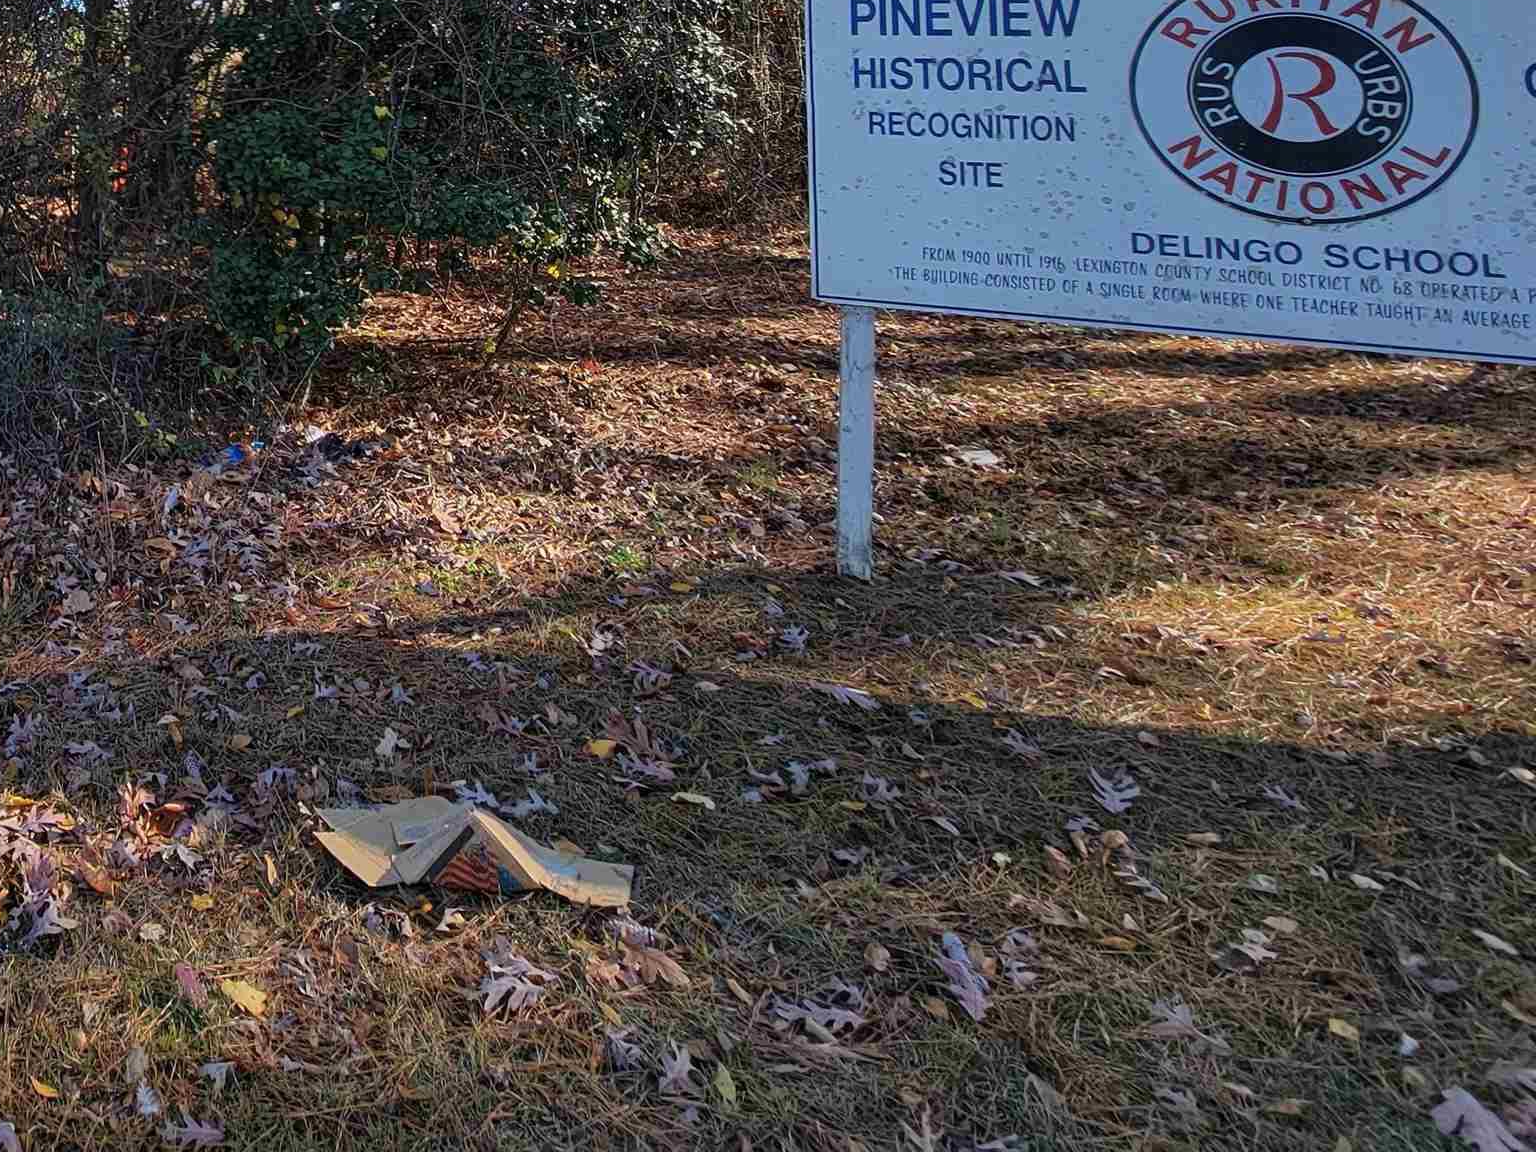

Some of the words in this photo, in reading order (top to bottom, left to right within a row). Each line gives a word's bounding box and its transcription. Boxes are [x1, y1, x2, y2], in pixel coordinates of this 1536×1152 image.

[853, 56, 1088, 93] HISTORICAL
[1197, 56, 1239, 128] RUS
[1354, 50, 1402, 144] URBS
[1262, 51, 1340, 136] R
[868, 111, 1076, 142] RECOGNITION
[938, 159, 1005, 188] SITE
[1167, 134, 1452, 215] NATIONAL
[922, 247, 956, 262] FROM
[961, 250, 991, 266] 1900
[997, 252, 1033, 269] UNTIL
[1075, 257, 1148, 277] LEXINGTON
[1155, 262, 1211, 281] COUNTY
[1219, 267, 1275, 287] SCHOOL
[1282, 271, 1353, 292] DISTRICT
[1393, 279, 1413, 295] 68
[1420, 281, 1501, 302] OPERATED
[1511, 288, 1521, 303] A
[1131, 232, 1303, 265] DELINGO
[1324, 244, 1507, 279] SCHOOL
[894, 266, 917, 280] THE
[923, 269, 979, 287] BUILDING
[984, 273, 1056, 293] CONSISTED
[1062, 279, 1080, 294] OF
[1085, 280, 1094, 295] A
[1099, 282, 1145, 299] SINGLE
[1152, 286, 1192, 303] ROOM
[1200, 290, 1248, 309] WHERE
[1256, 294, 1284, 310] ONE
[1293, 296, 1359, 317] TEACHER
[1367, 299, 1424, 322] TAUGHT
[1433, 306, 1453, 324] AN
[1463, 309, 1531, 329] AVERAGE
